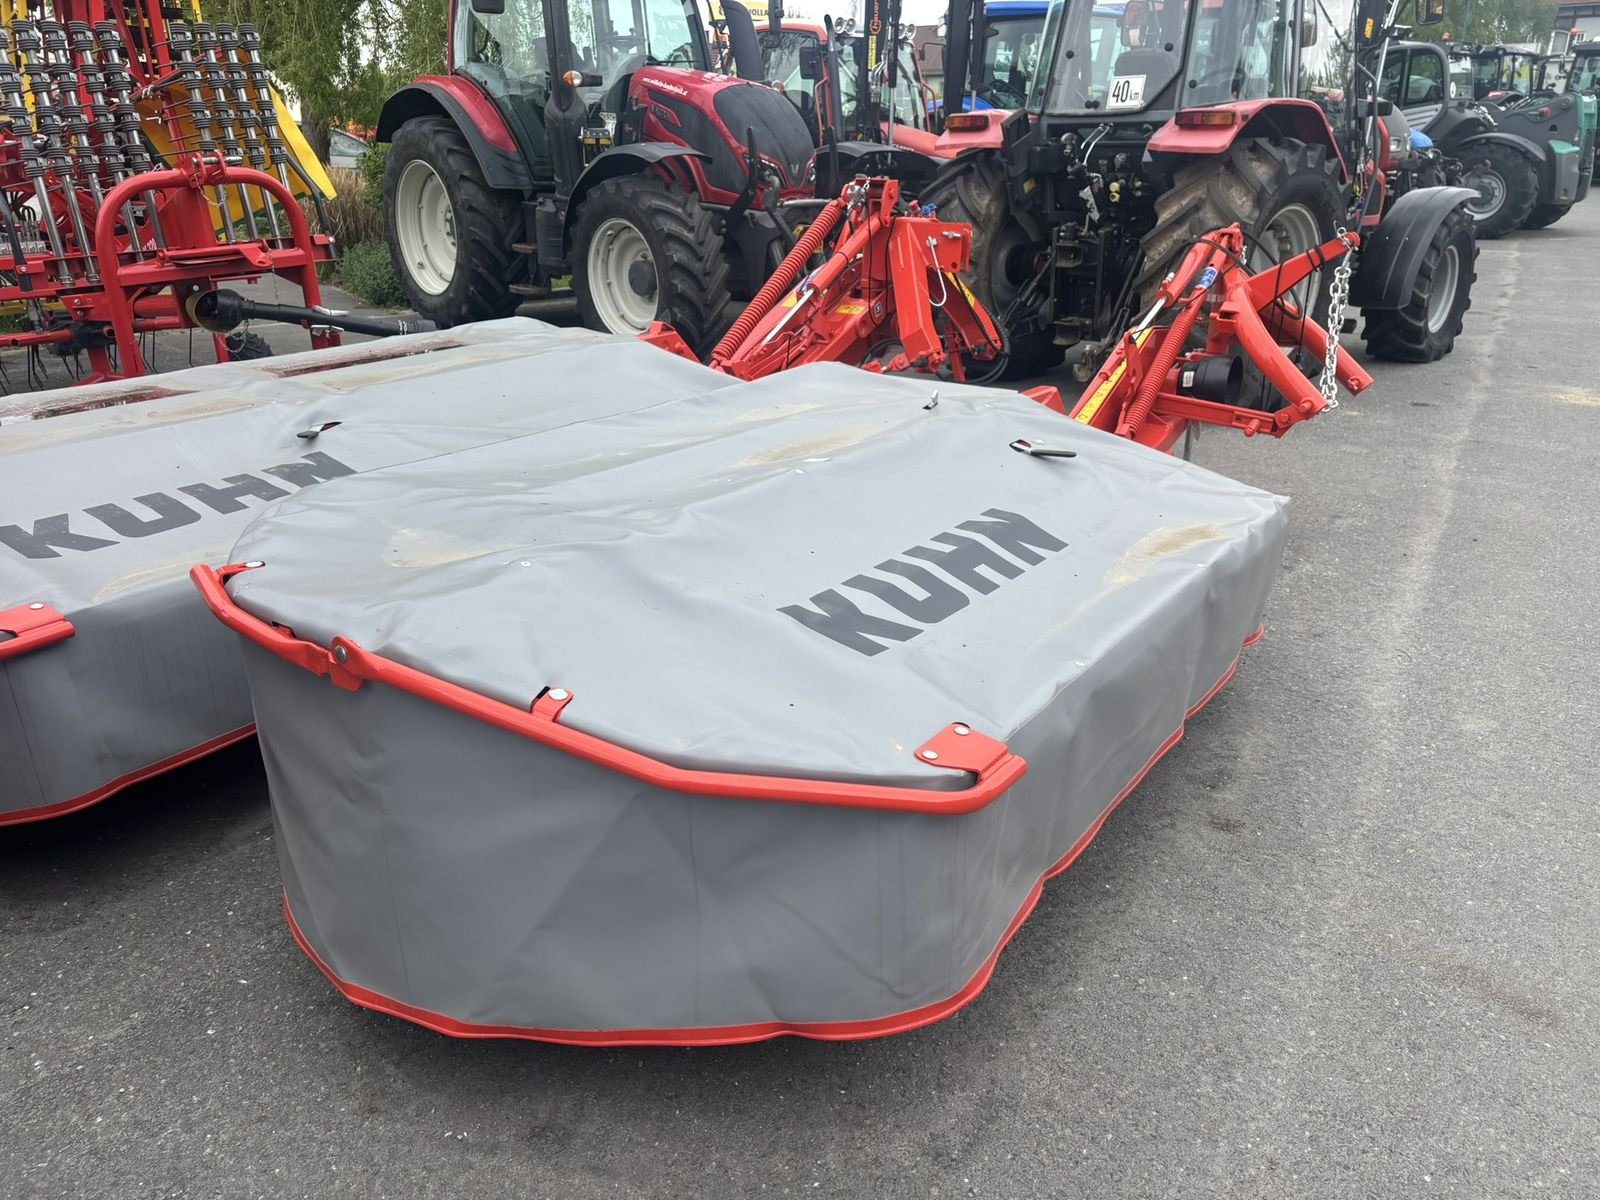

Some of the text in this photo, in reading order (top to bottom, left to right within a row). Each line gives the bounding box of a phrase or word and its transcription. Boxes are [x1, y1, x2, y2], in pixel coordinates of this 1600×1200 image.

[1112, 80, 1130, 103] 40
[0, 451, 358, 559] KUHN
[776, 508, 1070, 657] KUHN
